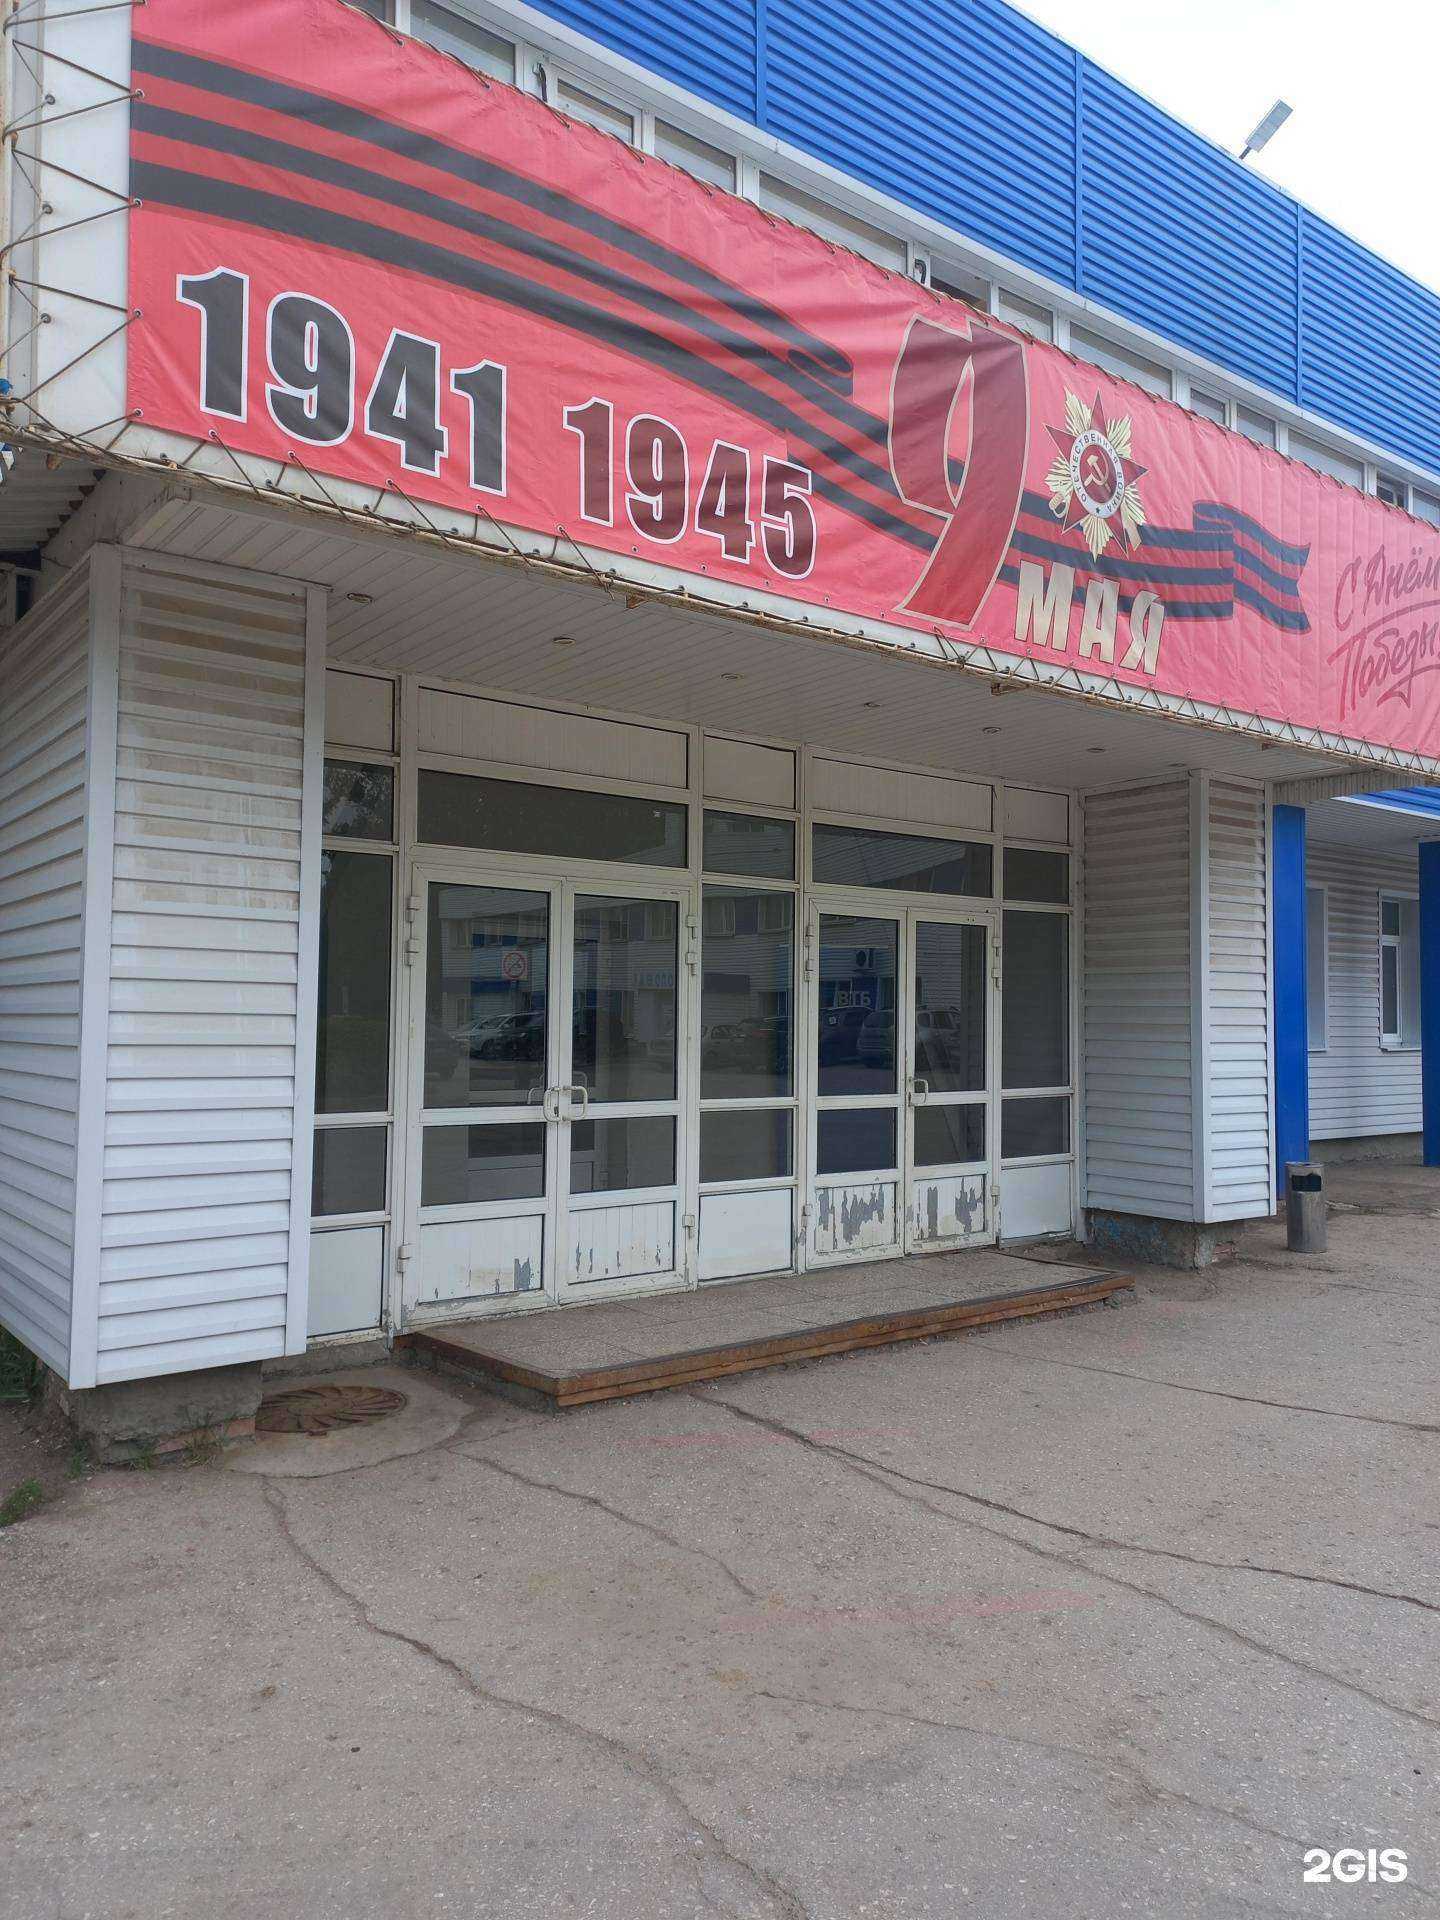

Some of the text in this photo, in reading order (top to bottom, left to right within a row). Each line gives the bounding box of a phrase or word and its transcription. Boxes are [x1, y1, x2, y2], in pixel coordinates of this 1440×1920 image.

[176, 266, 816, 580] 1941 1945
[888, 312, 1167, 677] 9 МАЯ
